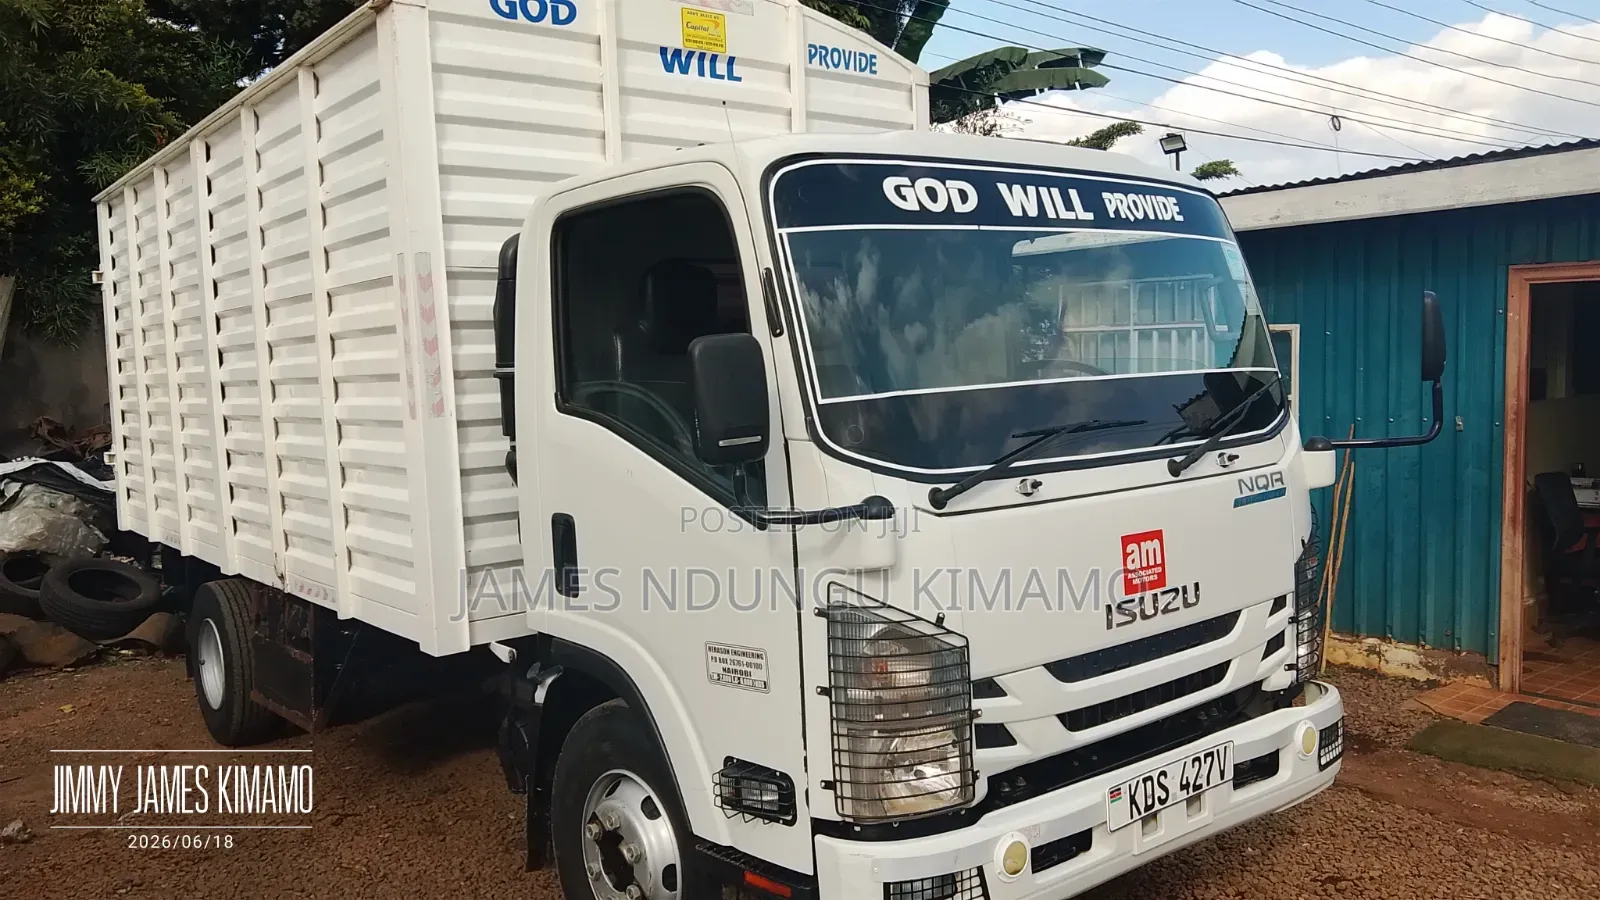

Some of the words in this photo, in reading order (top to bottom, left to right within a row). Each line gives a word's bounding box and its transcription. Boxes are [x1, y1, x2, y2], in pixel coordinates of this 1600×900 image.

[489, 0, 577, 26] GOD
[659, 46, 743, 83] WILL
[807, 43, 878, 76] PROVIDE
[882, 175, 979, 213] GOD
[996, 182, 1095, 221] WILL
[1102, 192, 1185, 222] PROVIDE
[1237, 470, 1285, 495] NQR
[1126, 538, 1162, 570] am
[1127, 566, 1162, 580] ASSOCIATED
[1132, 573, 1158, 585] MOTORS
[1105, 581, 1200, 630] ISUZU
[718, 656, 729, 665] BOX
[730, 648, 764, 661] ENGINEERING
[722, 666, 752, 678] NAIROBI
[1128, 769, 1170, 820] KDS
[1179, 745, 1228, 796] 427V
